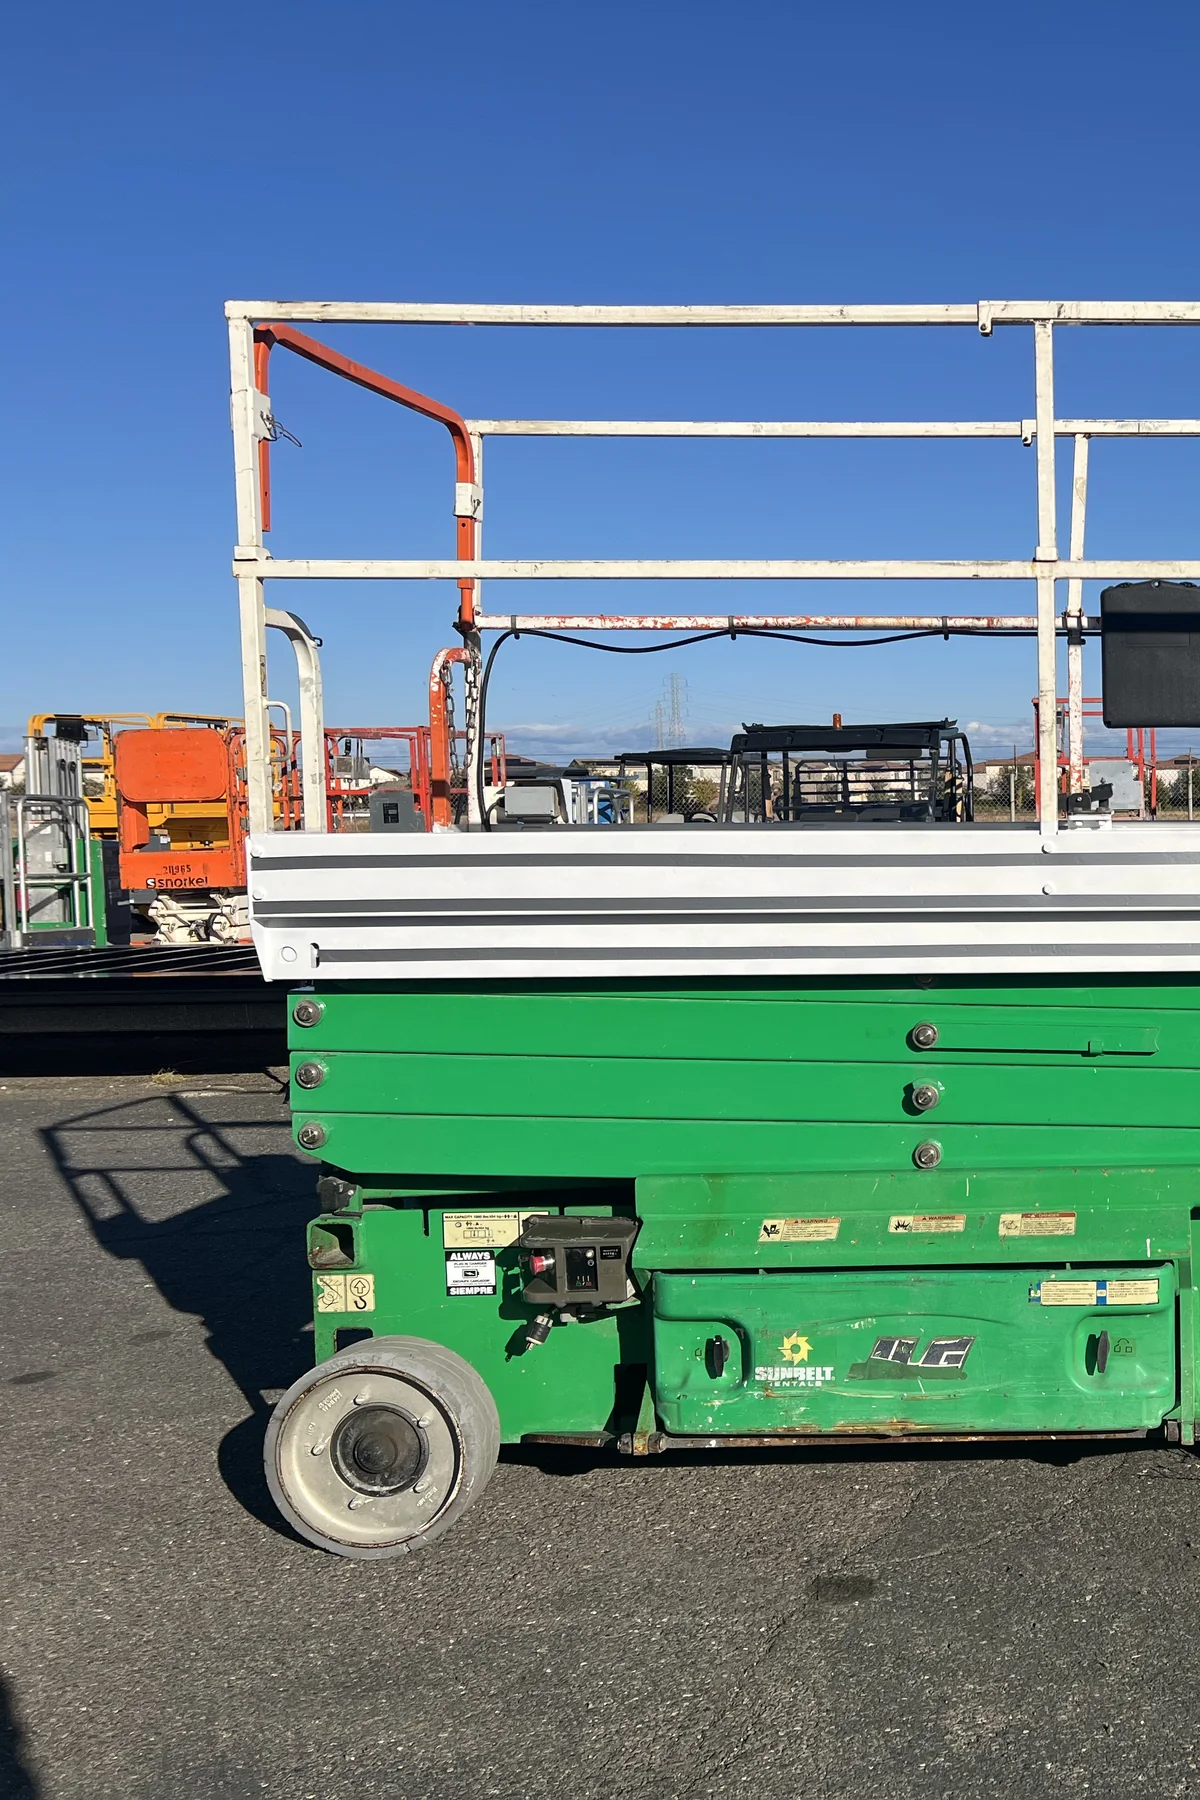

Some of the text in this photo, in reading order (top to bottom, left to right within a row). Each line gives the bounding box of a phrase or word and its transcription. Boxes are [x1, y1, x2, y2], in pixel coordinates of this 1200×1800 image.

[158, 876, 208, 888] snorkel
[450, 1252, 490, 1260] ALWAYS
[449, 1286, 493, 1295] SIEMPRE
[755, 1367, 834, 1381] SUNBELT
